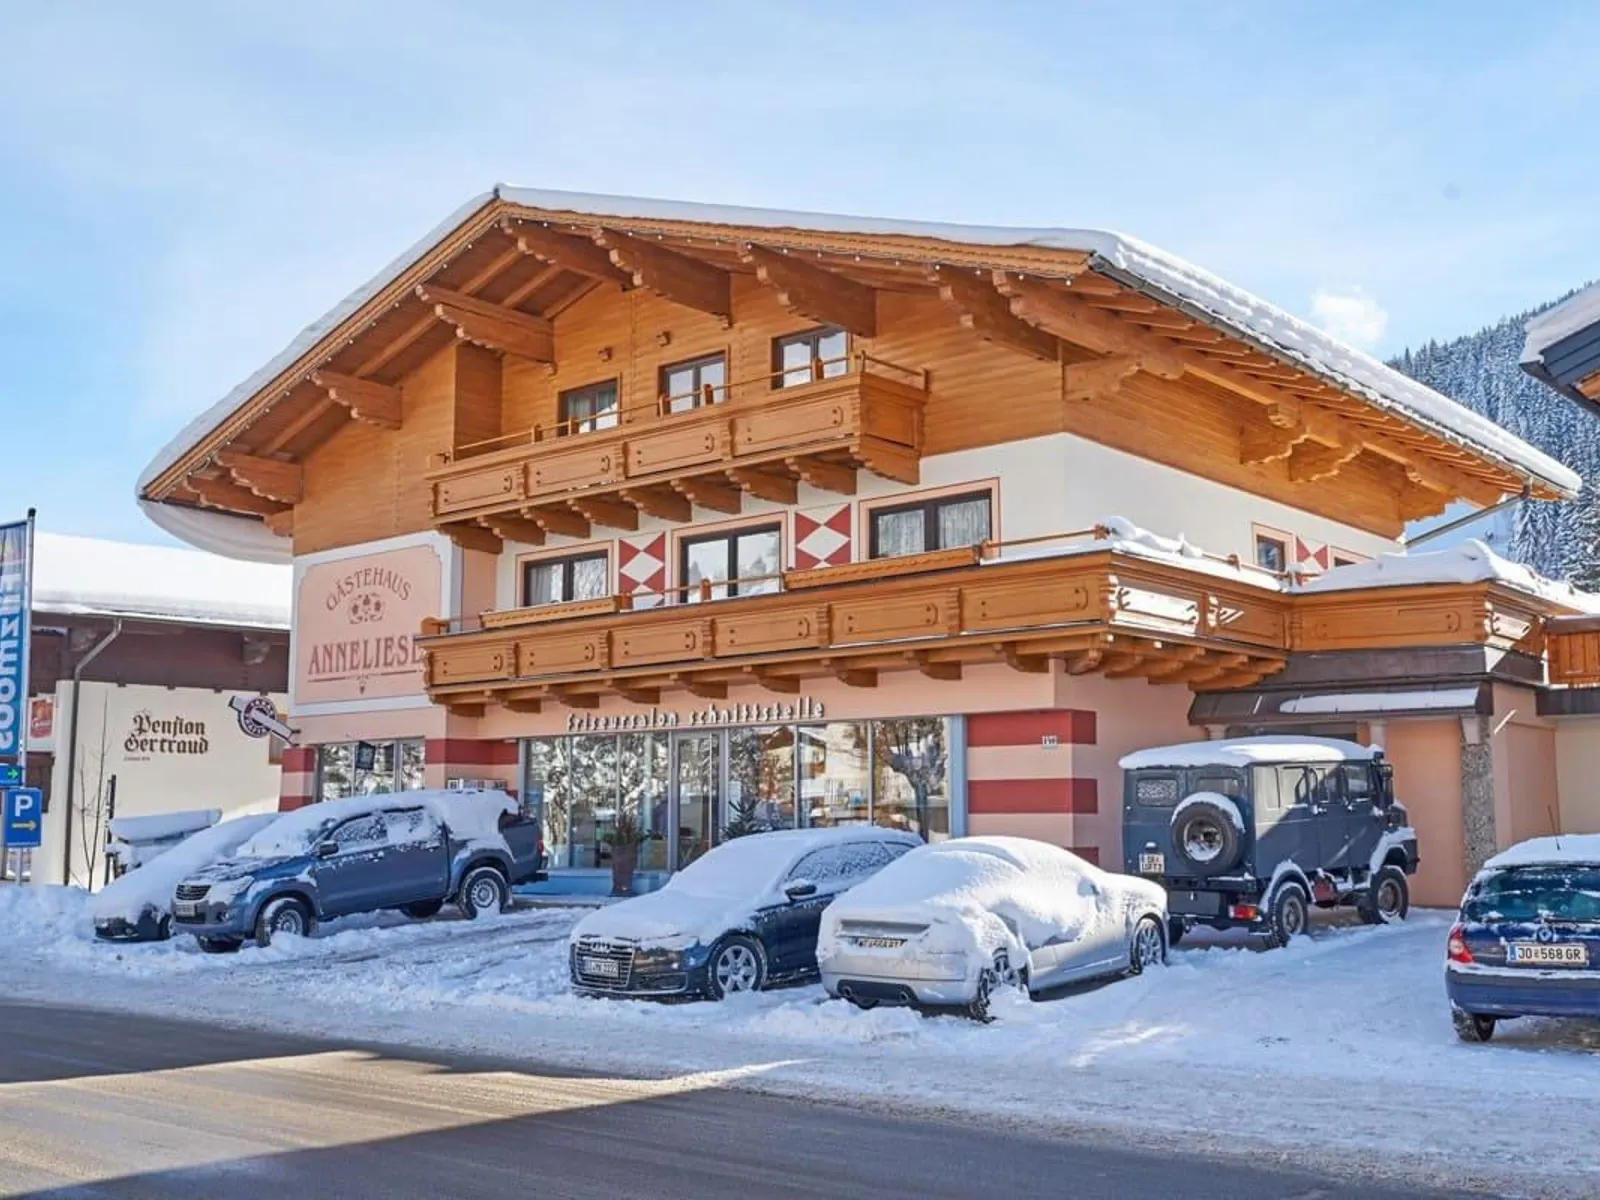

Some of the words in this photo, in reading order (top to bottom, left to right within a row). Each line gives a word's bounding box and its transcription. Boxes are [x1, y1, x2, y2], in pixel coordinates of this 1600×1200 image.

[326, 567, 412, 611] GÄSTEHAUS
[567, 707, 679, 733] friseursalon
[689, 696, 824, 727] schnittstelle
[124, 732, 209, 755] Gertraud
[14, 795, 33, 817] P
[1565, 948, 1581, 961] GR
